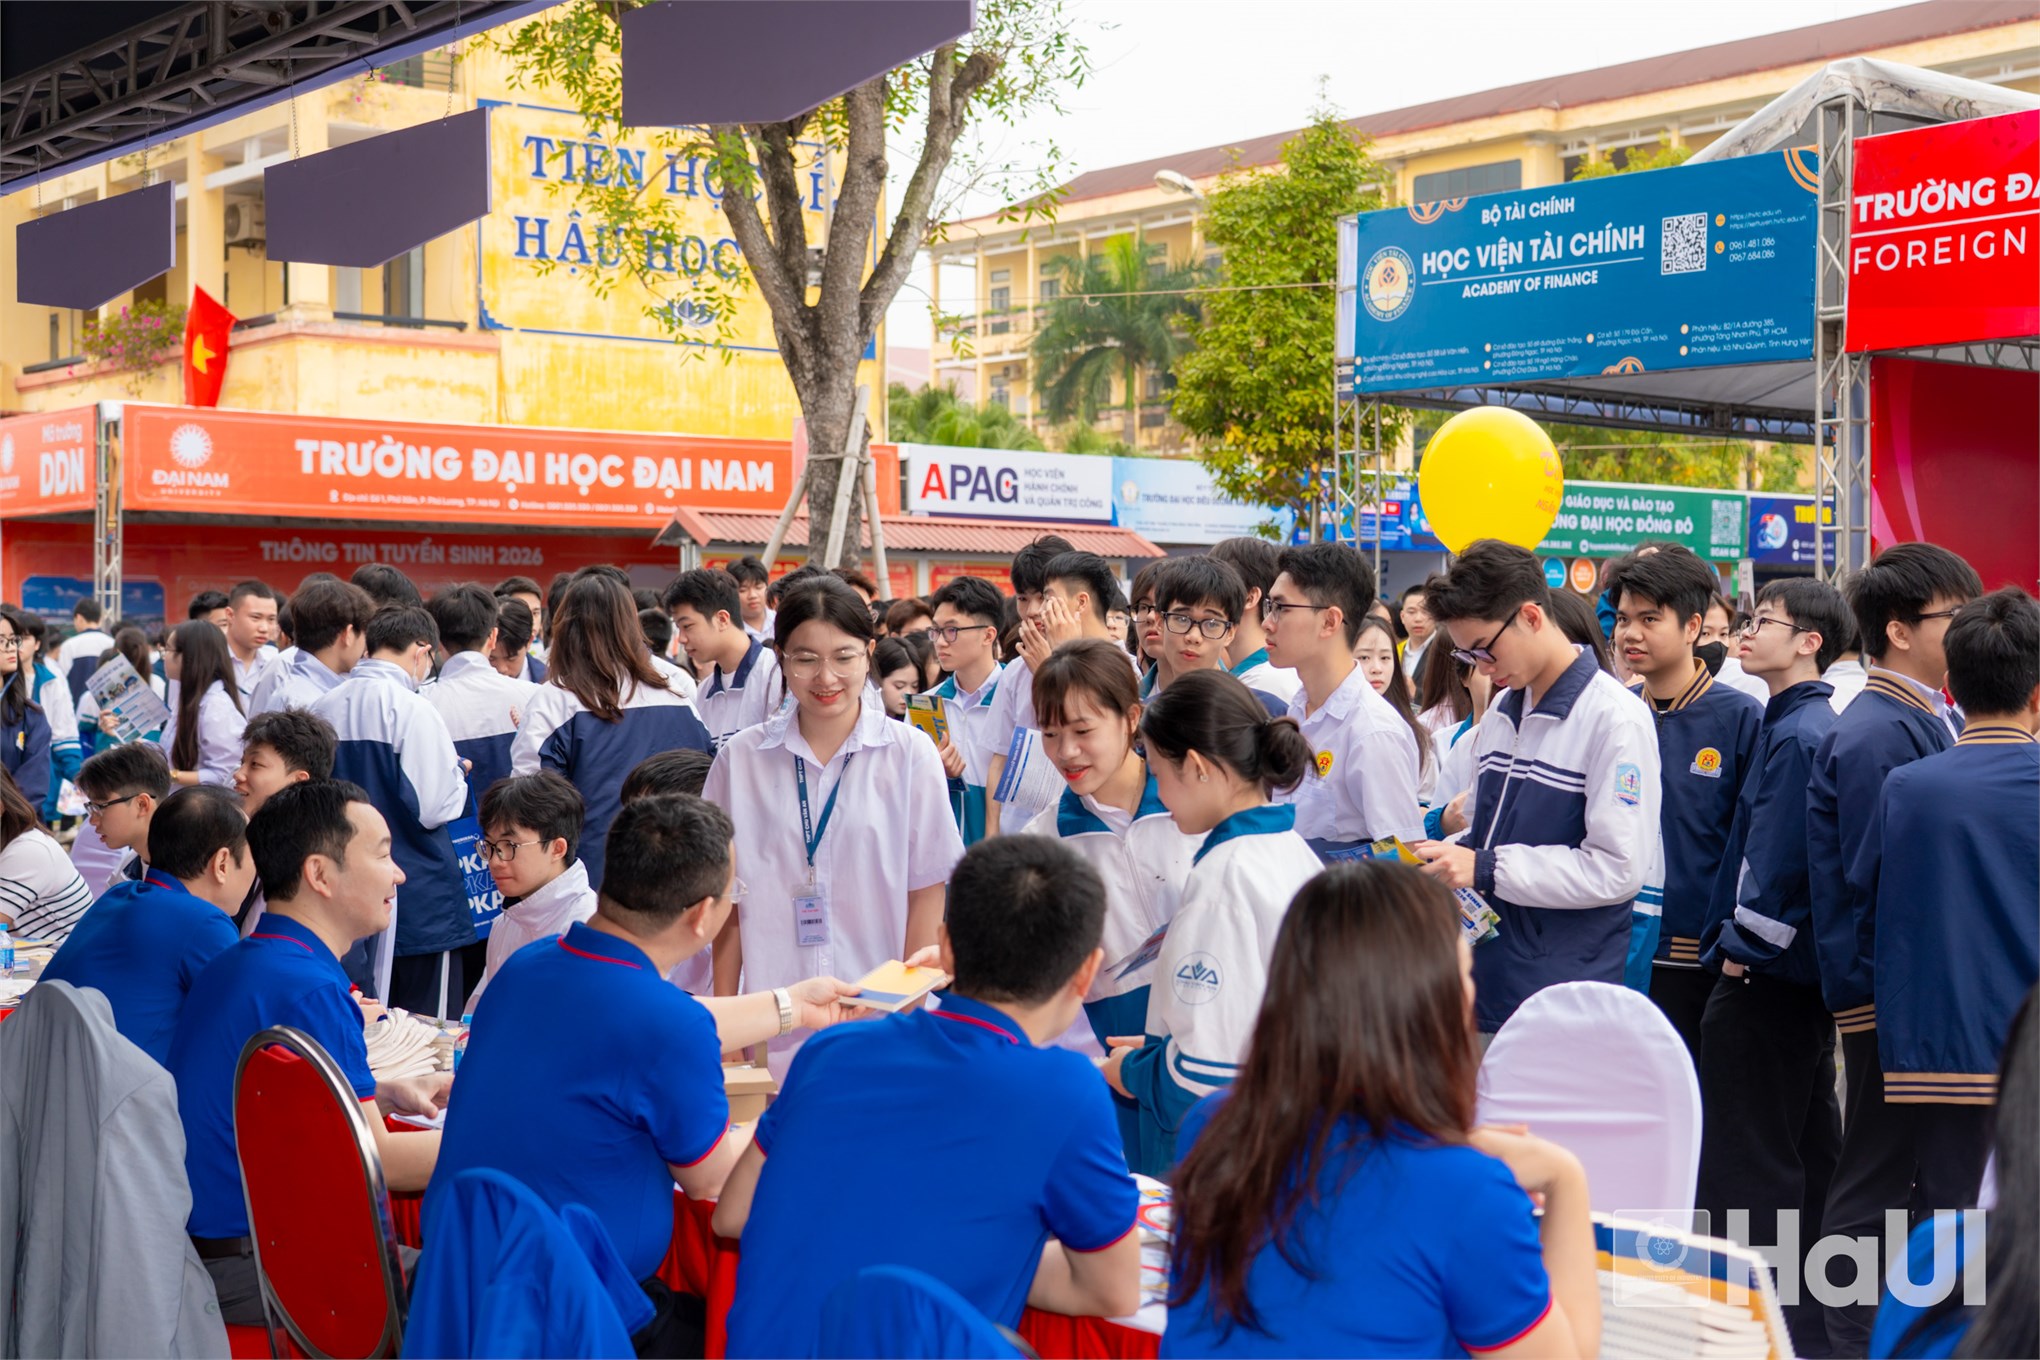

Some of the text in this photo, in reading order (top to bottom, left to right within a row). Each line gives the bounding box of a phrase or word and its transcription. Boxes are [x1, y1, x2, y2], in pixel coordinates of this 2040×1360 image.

[1481, 195, 1575, 227] BỘ TÀI CHÍNH
[1854, 172, 2040, 223] TRƯỜNG Đ
[1422, 222, 1645, 279] HỌC VIỆN TÀI CHÍNH
[1729, 237, 1776, 251] 0961.481.086
[1729, 250, 1776, 264] 0967.684.086
[1854, 226, 2026, 275] FOREIGN
[1462, 270, 1598, 299] ACADEMY OF FINANCE
[40, 447, 85, 497] DDN
[152, 469, 229, 488] ĐẠI NAM
[294, 434, 774, 499] TRƯỜNG ĐẠI HỌC ĐẠI NAM
[1024, 467, 1065, 480] HỌC VIỆN
[920, 463, 1018, 503] APAG
[1565, 492, 1591, 509] GIÁO
[1593, 497, 1614, 512] DỤC
[1616, 495, 1630, 511] VÀ
[1632, 496, 1653, 512] ĐÀO
[1655, 500, 1674, 515] TẠO
[1580, 515, 1602, 535] ĐẠI
[1605, 516, 1633, 535] HỌC
[1636, 514, 1672, 534] ĐÔNG
[1674, 515, 1693, 535] ĐÔ
[260, 537, 544, 567] THÔNG TIN TUYỂN SINH 2026
